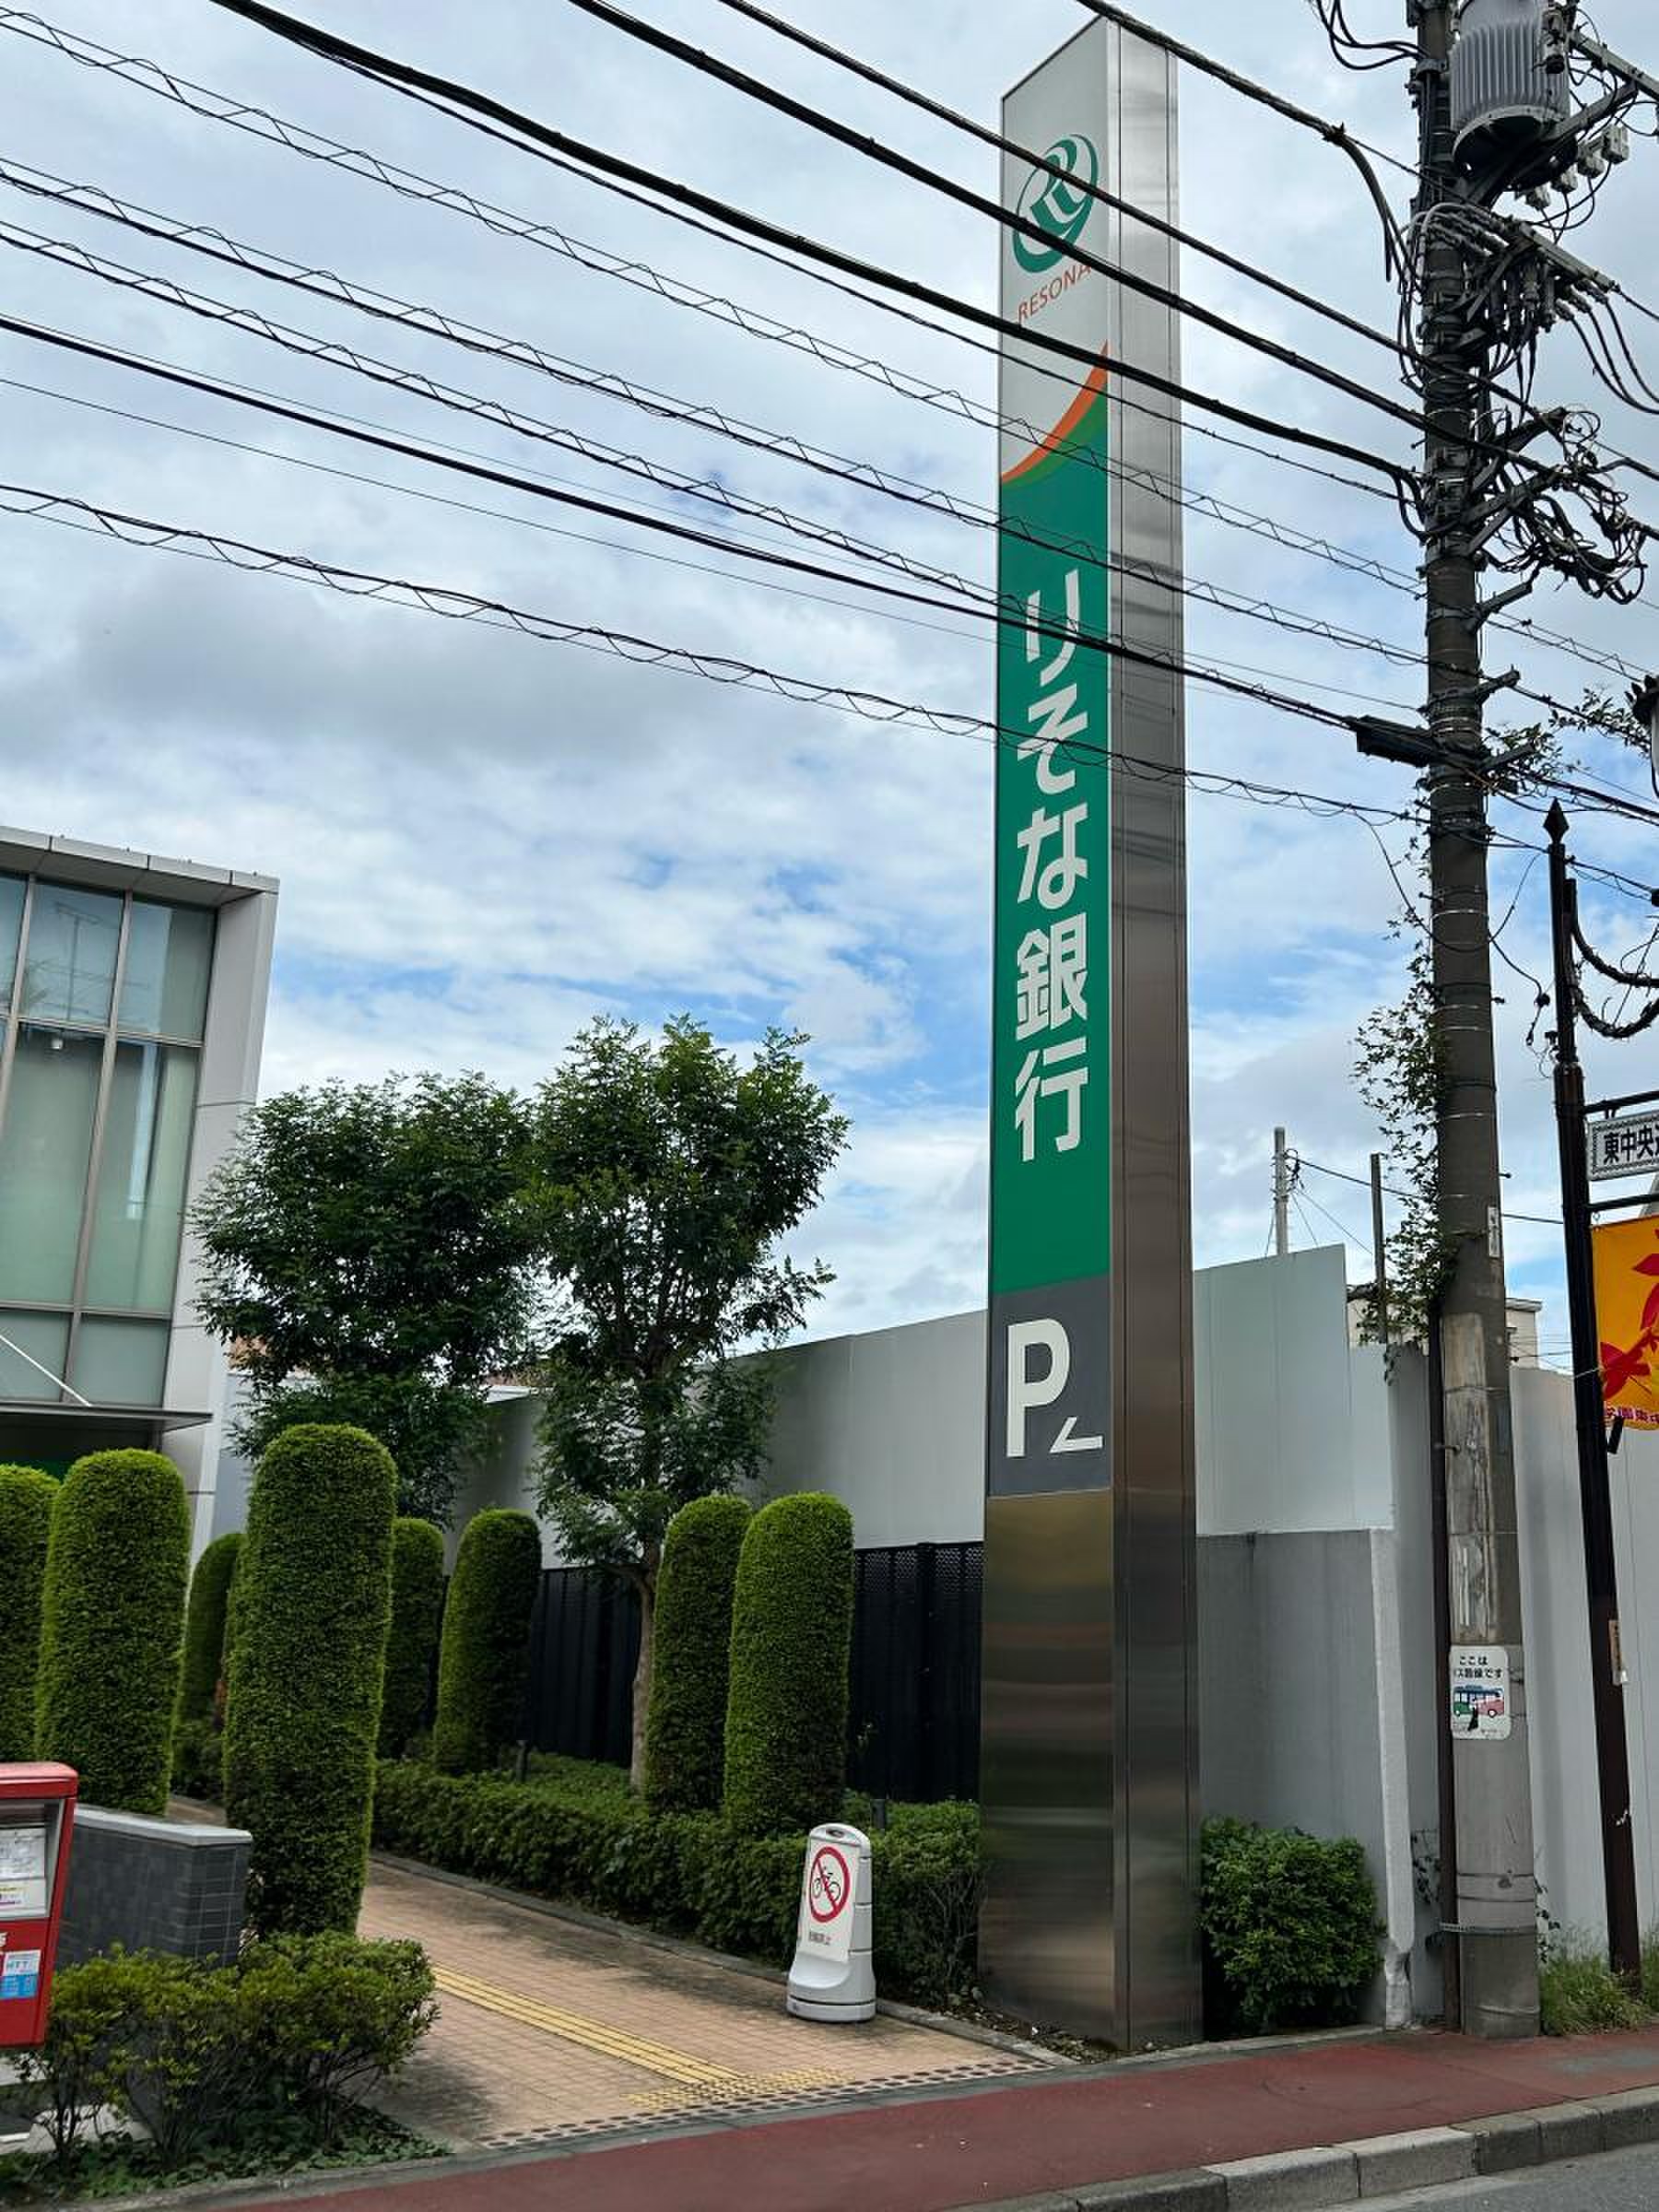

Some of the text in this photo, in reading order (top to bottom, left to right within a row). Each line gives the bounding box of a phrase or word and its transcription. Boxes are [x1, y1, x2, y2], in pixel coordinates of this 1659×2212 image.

[1018, 260, 1092, 324] RESONA
[1015, 569, 1088, 1161] りそな銀行
[1604, 1124, 1659, 1163] 東中央
[1006, 1318, 1070, 1457] P
[1459, 1655, 1488, 1665] ここは
